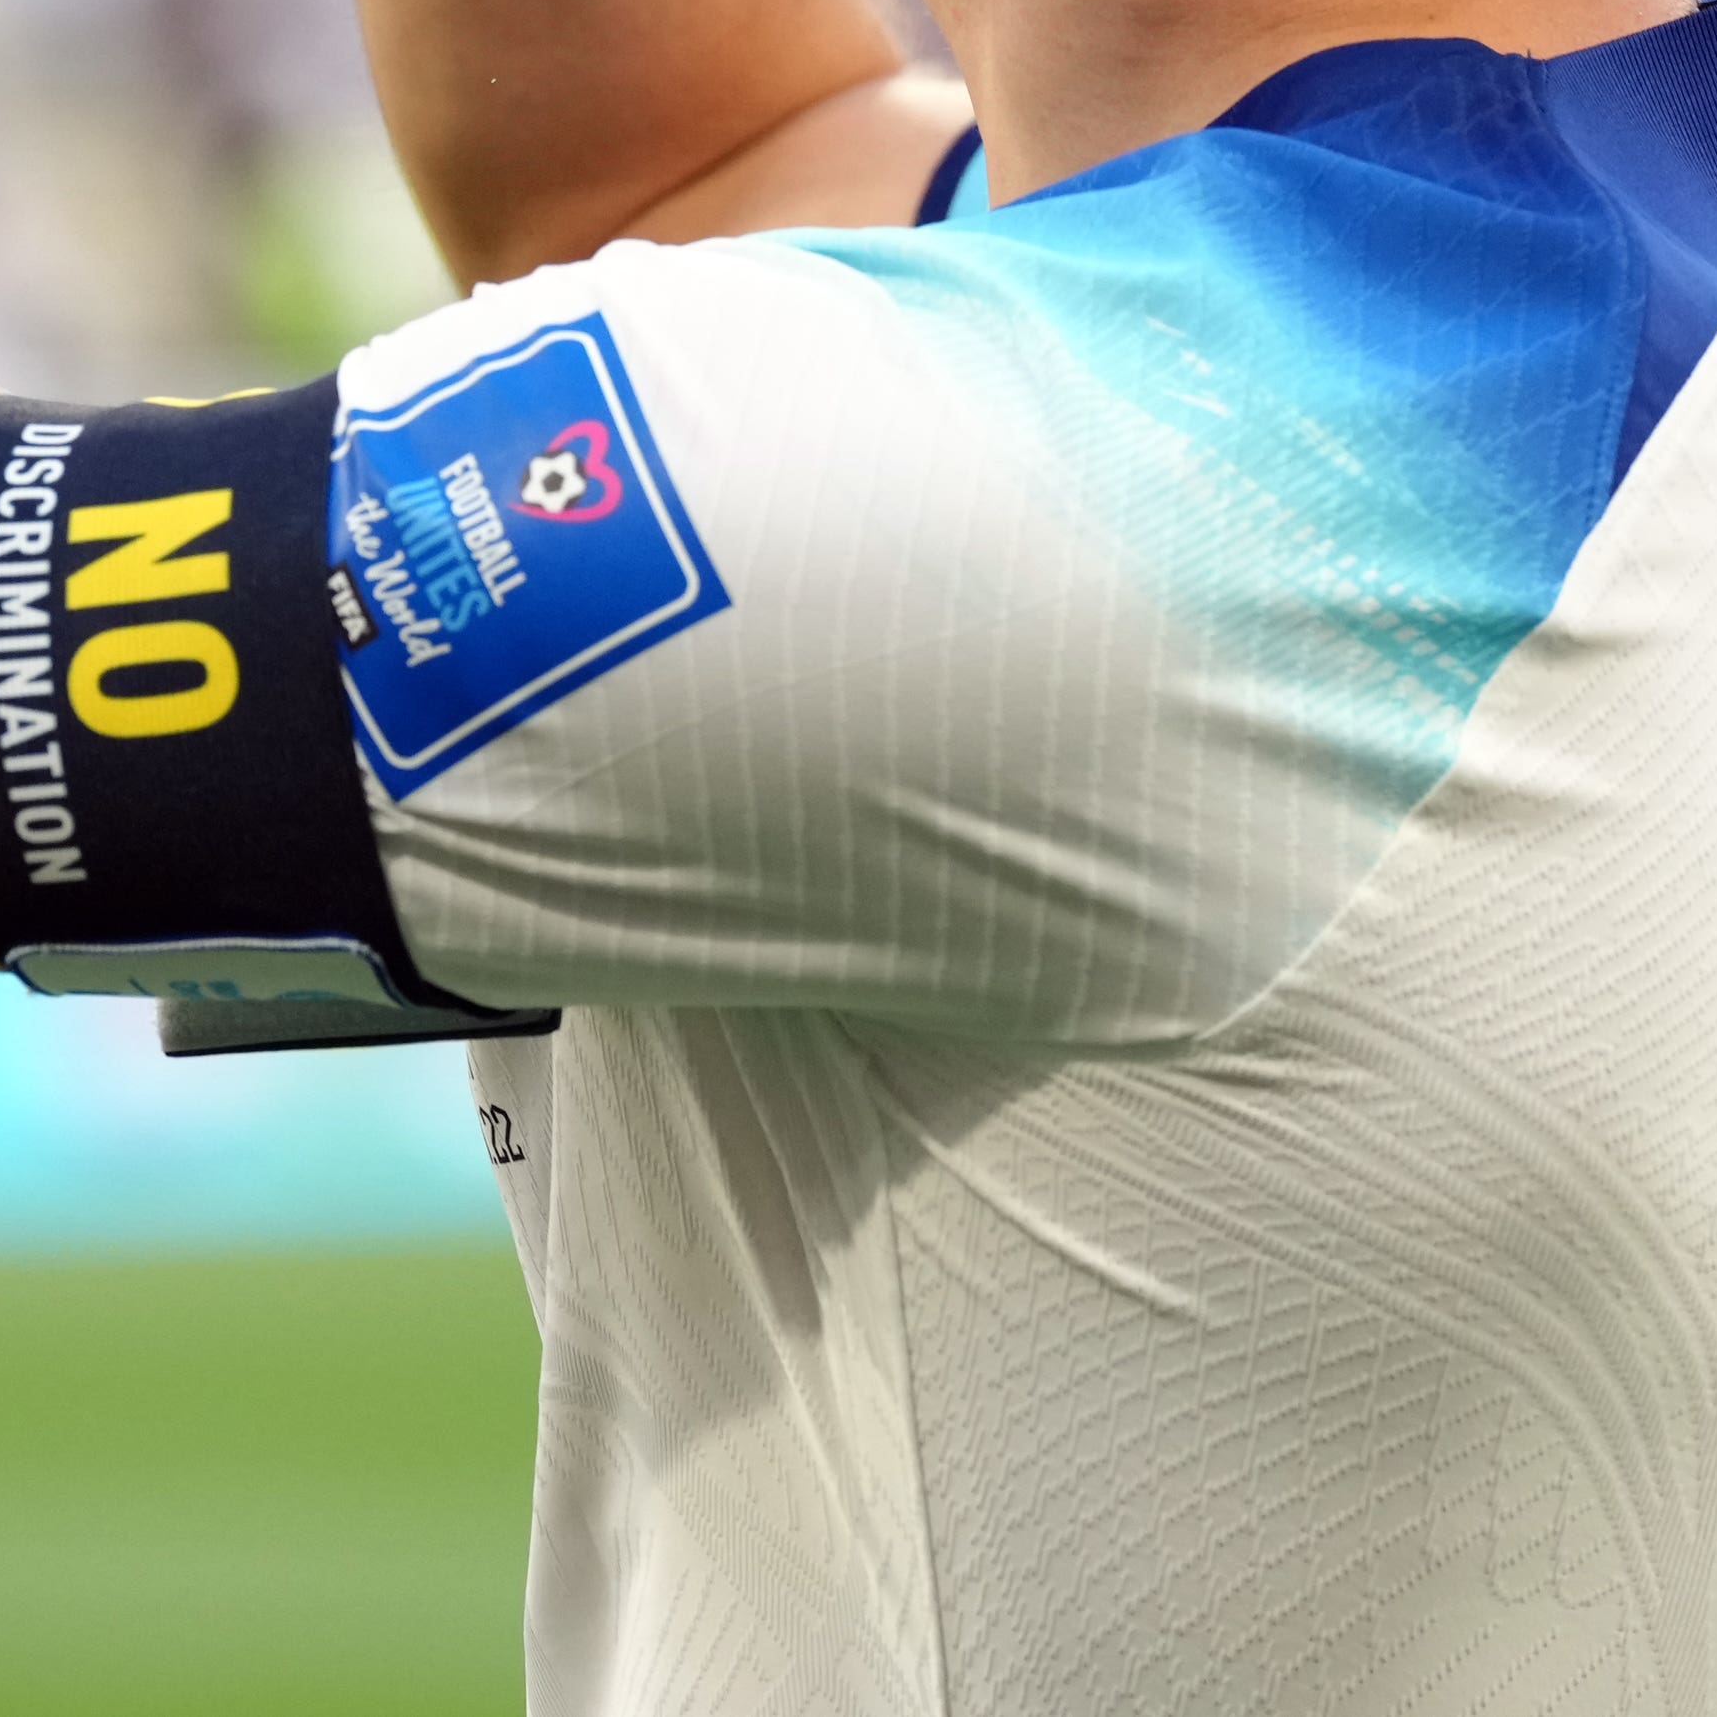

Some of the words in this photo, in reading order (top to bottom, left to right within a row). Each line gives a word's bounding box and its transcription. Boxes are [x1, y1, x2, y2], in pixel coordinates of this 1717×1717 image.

[346, 492, 389, 559] the
[386, 477, 490, 632] UNITES
[439, 453, 527, 607] FOOTBALL
[65, 488, 240, 739] NO
[328, 570, 369, 643] FIFA
[364, 550, 452, 667] World
